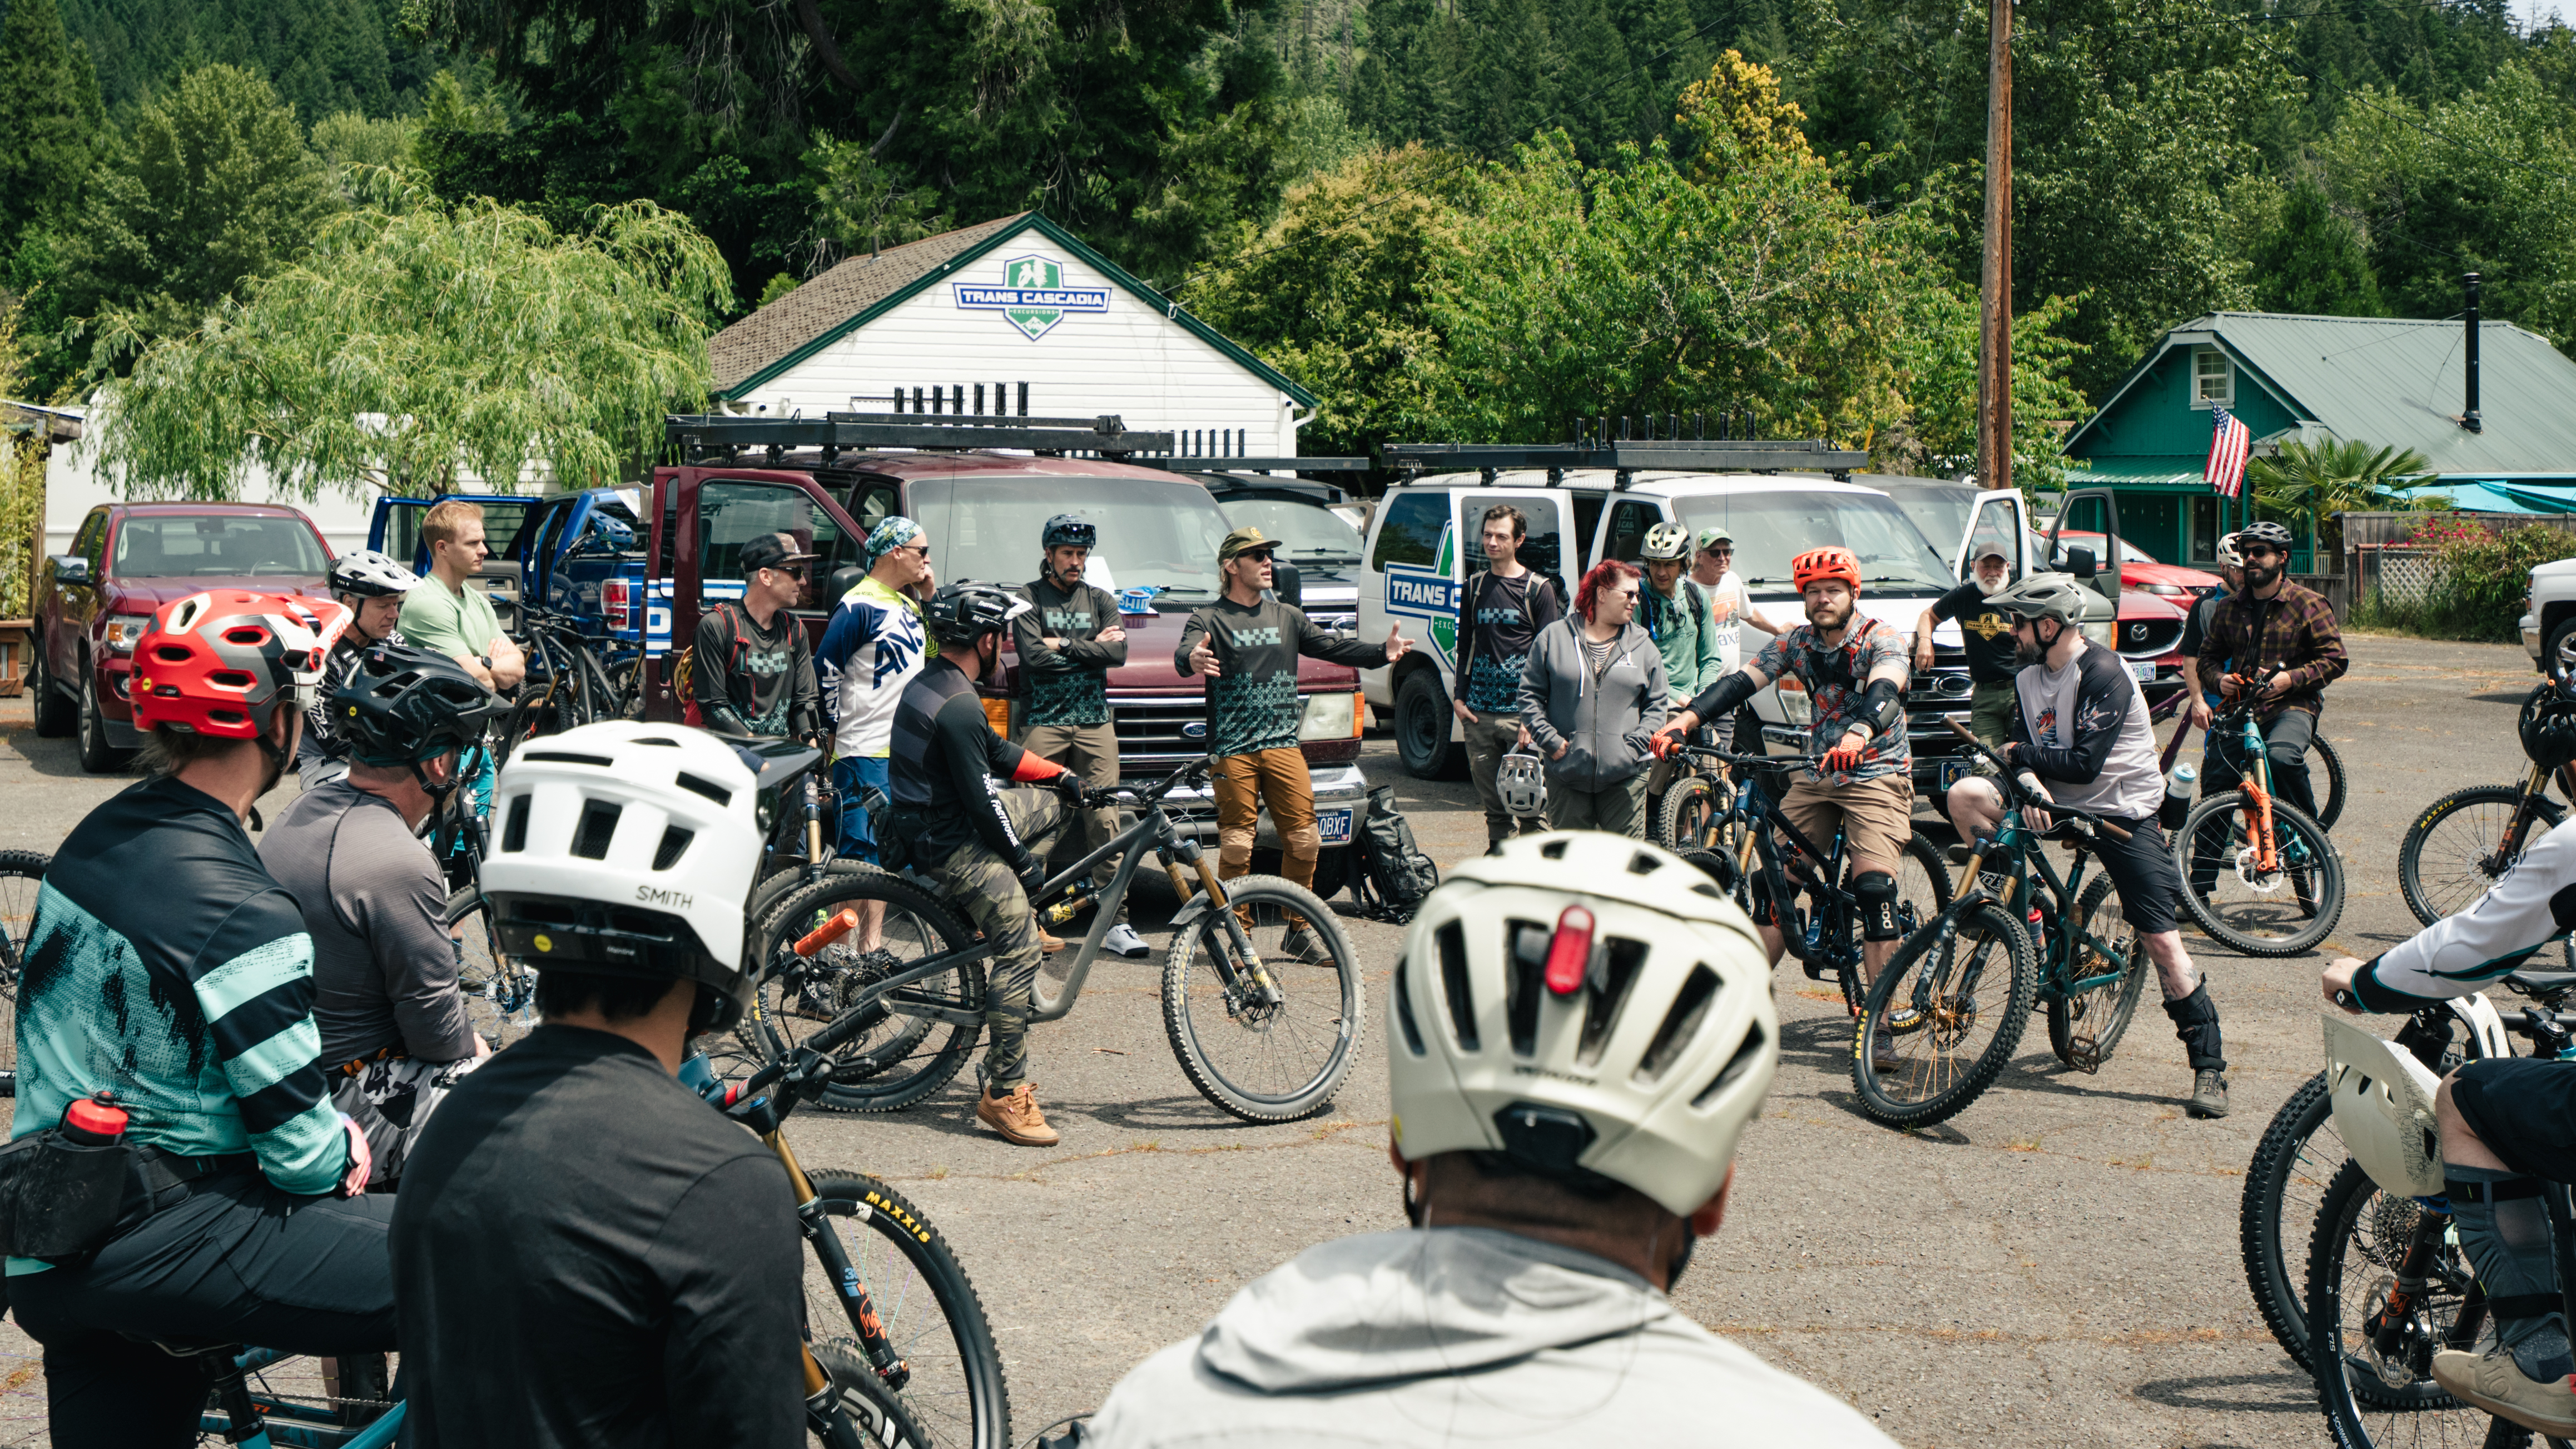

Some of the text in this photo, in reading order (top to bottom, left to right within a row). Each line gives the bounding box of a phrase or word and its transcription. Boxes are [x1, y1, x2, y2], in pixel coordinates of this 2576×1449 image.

[962, 291, 1103, 305] TRANS CASCADIA
[1392, 580, 1445, 606] TRANS
[330, 618, 349, 648] BELL
[990, 799, 1020, 847] FASTHOUSE
[1319, 816, 1348, 836] QBXF
[2420, 800, 2454, 829] MAXXIS
[636, 885, 693, 909] SMITH
[607, 946, 636, 956] Mainline
[1179, 946, 1190, 1006] MAXXIS
[1919, 947, 1944, 985] FOX
[760, 997, 772, 1026] SWISS
[1855, 1009, 1869, 1059] MAXXIS
[865, 1191, 931, 1243] MAXXIS
